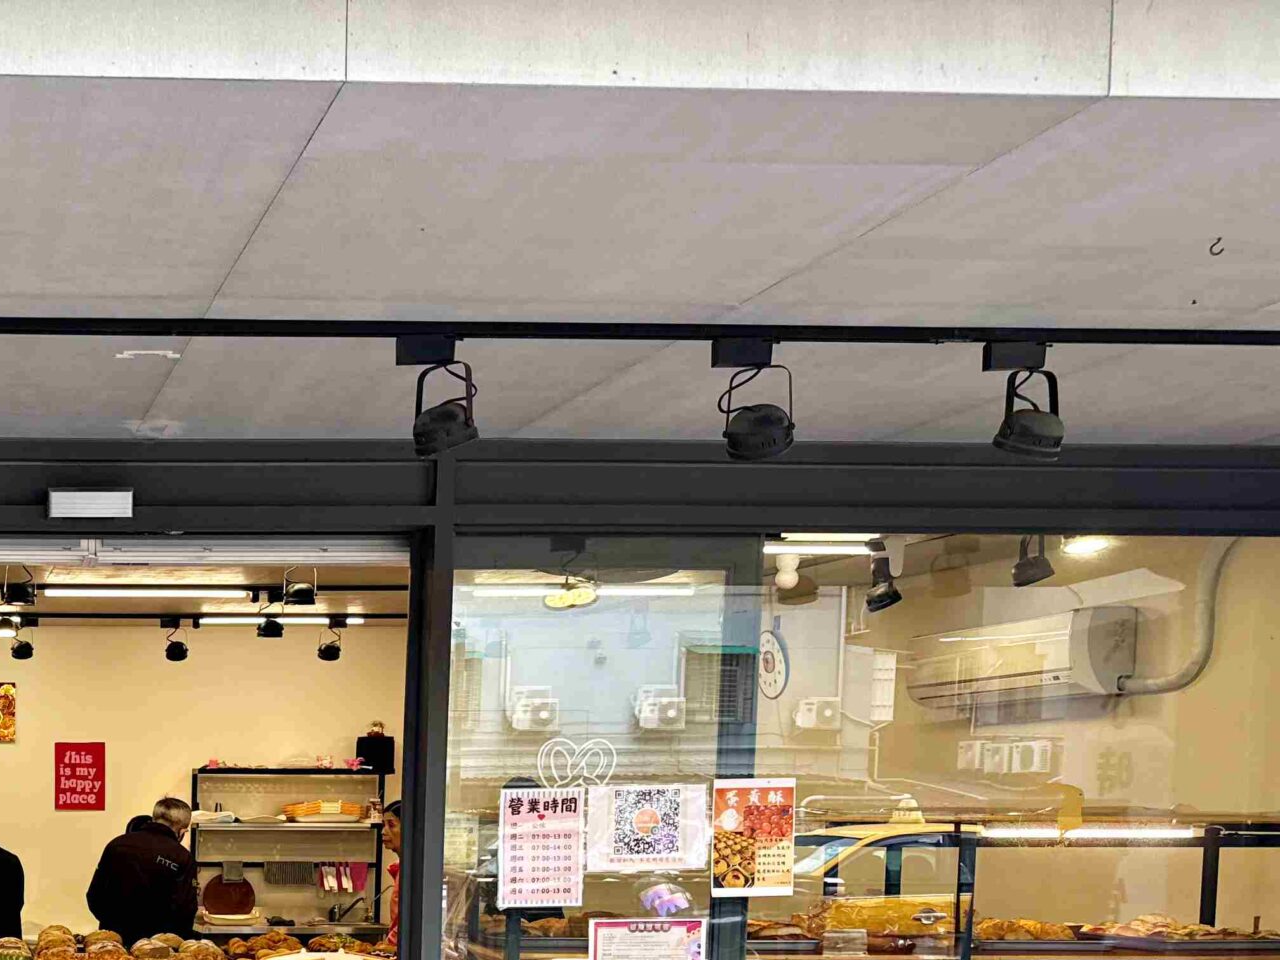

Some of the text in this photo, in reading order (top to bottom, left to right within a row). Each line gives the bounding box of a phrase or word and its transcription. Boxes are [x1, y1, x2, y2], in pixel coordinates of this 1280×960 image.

[59, 764, 97, 779] is my
[60, 777, 102, 792] happy
[58, 792, 97, 805] place
[725, 789, 785, 807] 蛋黃酥
[508, 797, 578, 816] 營業時間
